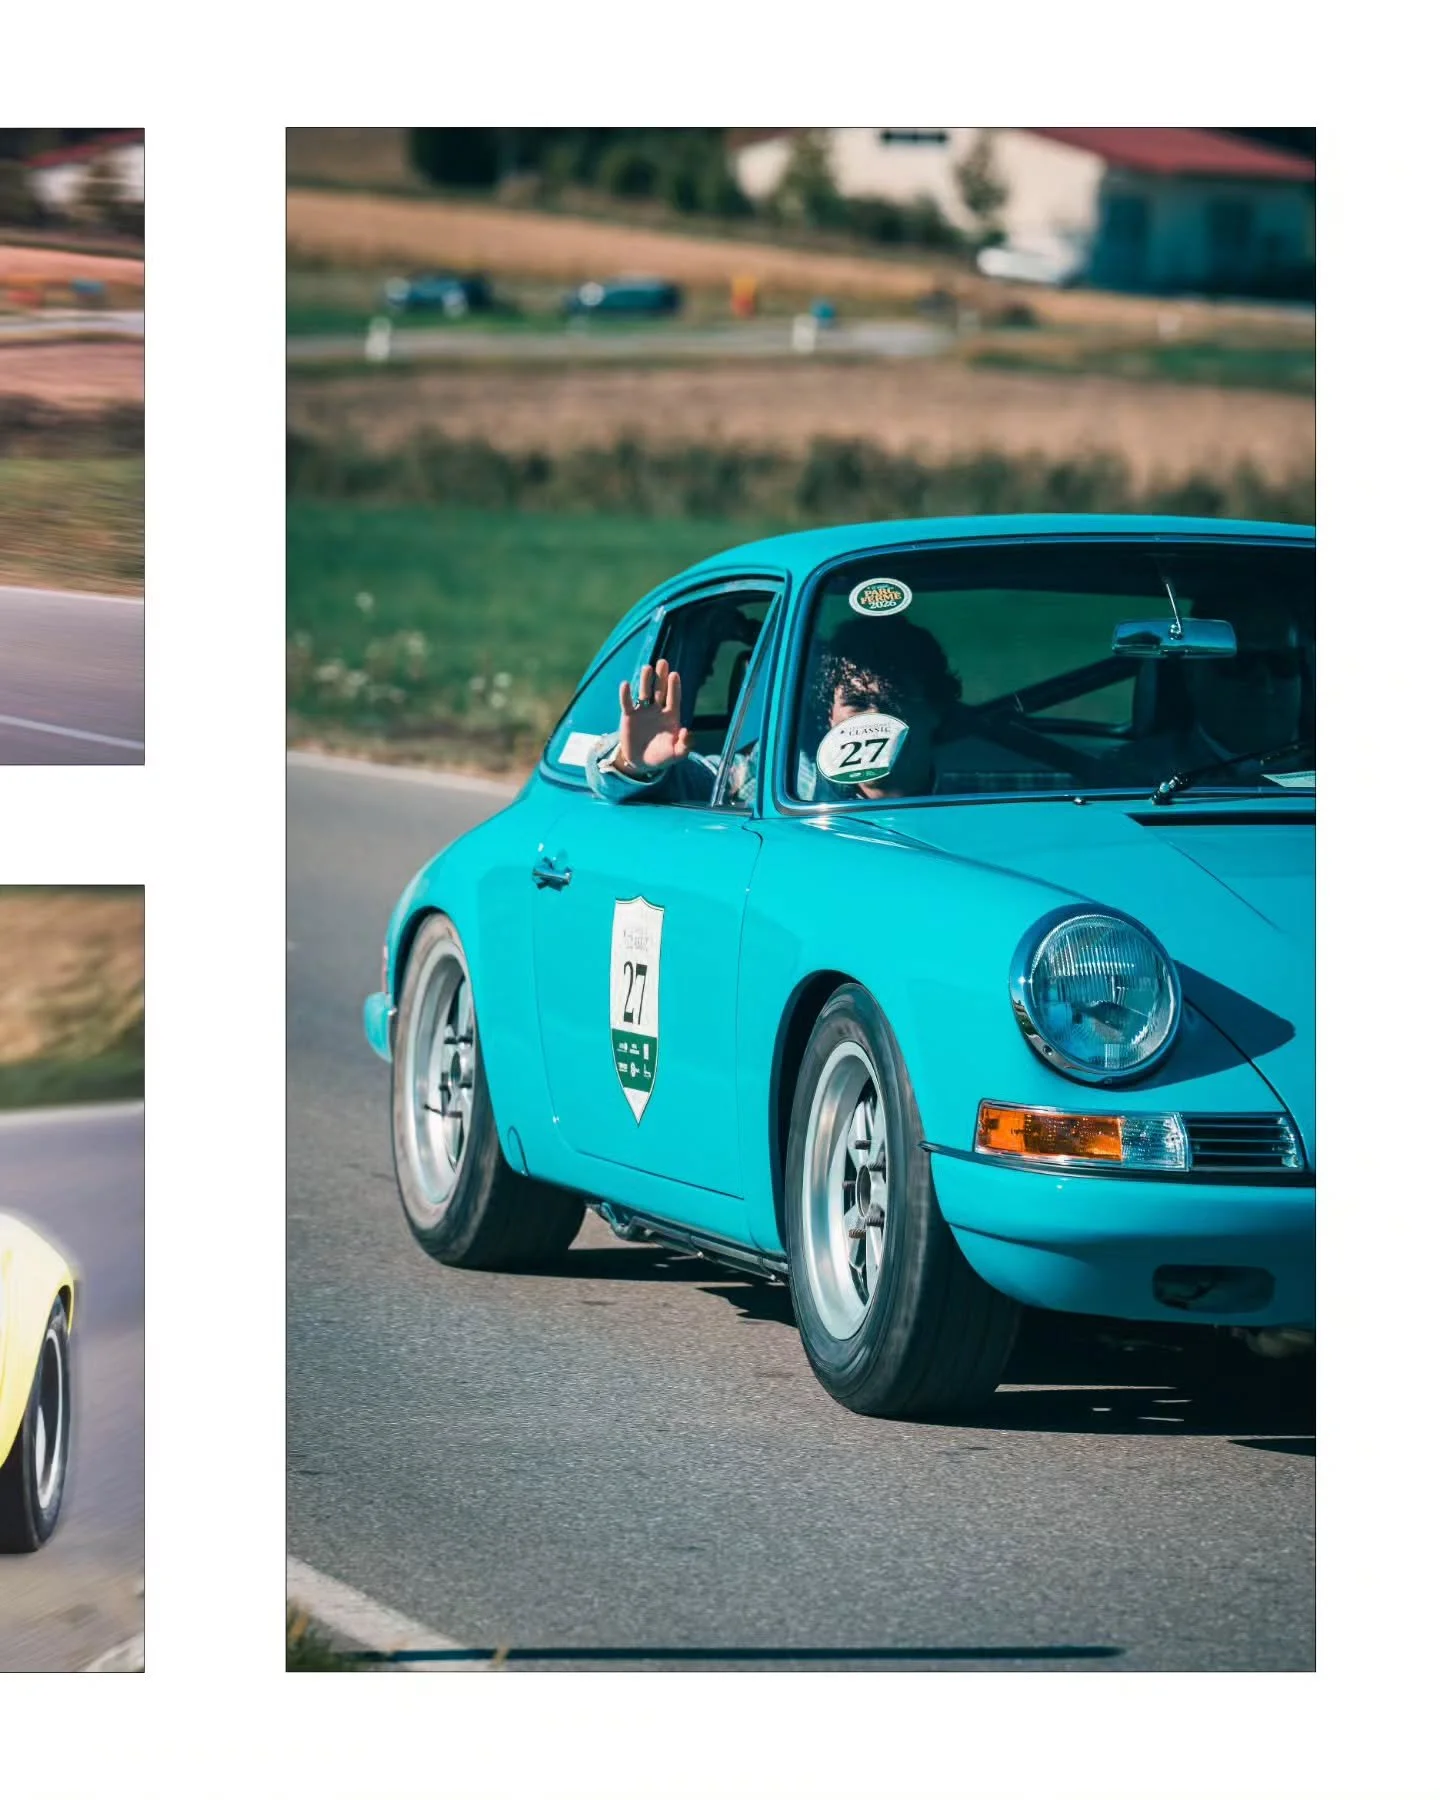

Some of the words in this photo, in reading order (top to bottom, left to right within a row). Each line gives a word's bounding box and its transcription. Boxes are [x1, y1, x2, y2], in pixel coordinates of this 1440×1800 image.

[864, 587, 895, 597] PARC
[869, 600, 897, 609] 2026
[849, 727, 890, 736] CLASSIC
[839, 738, 890, 768] 27
[623, 961, 648, 1025] 27
